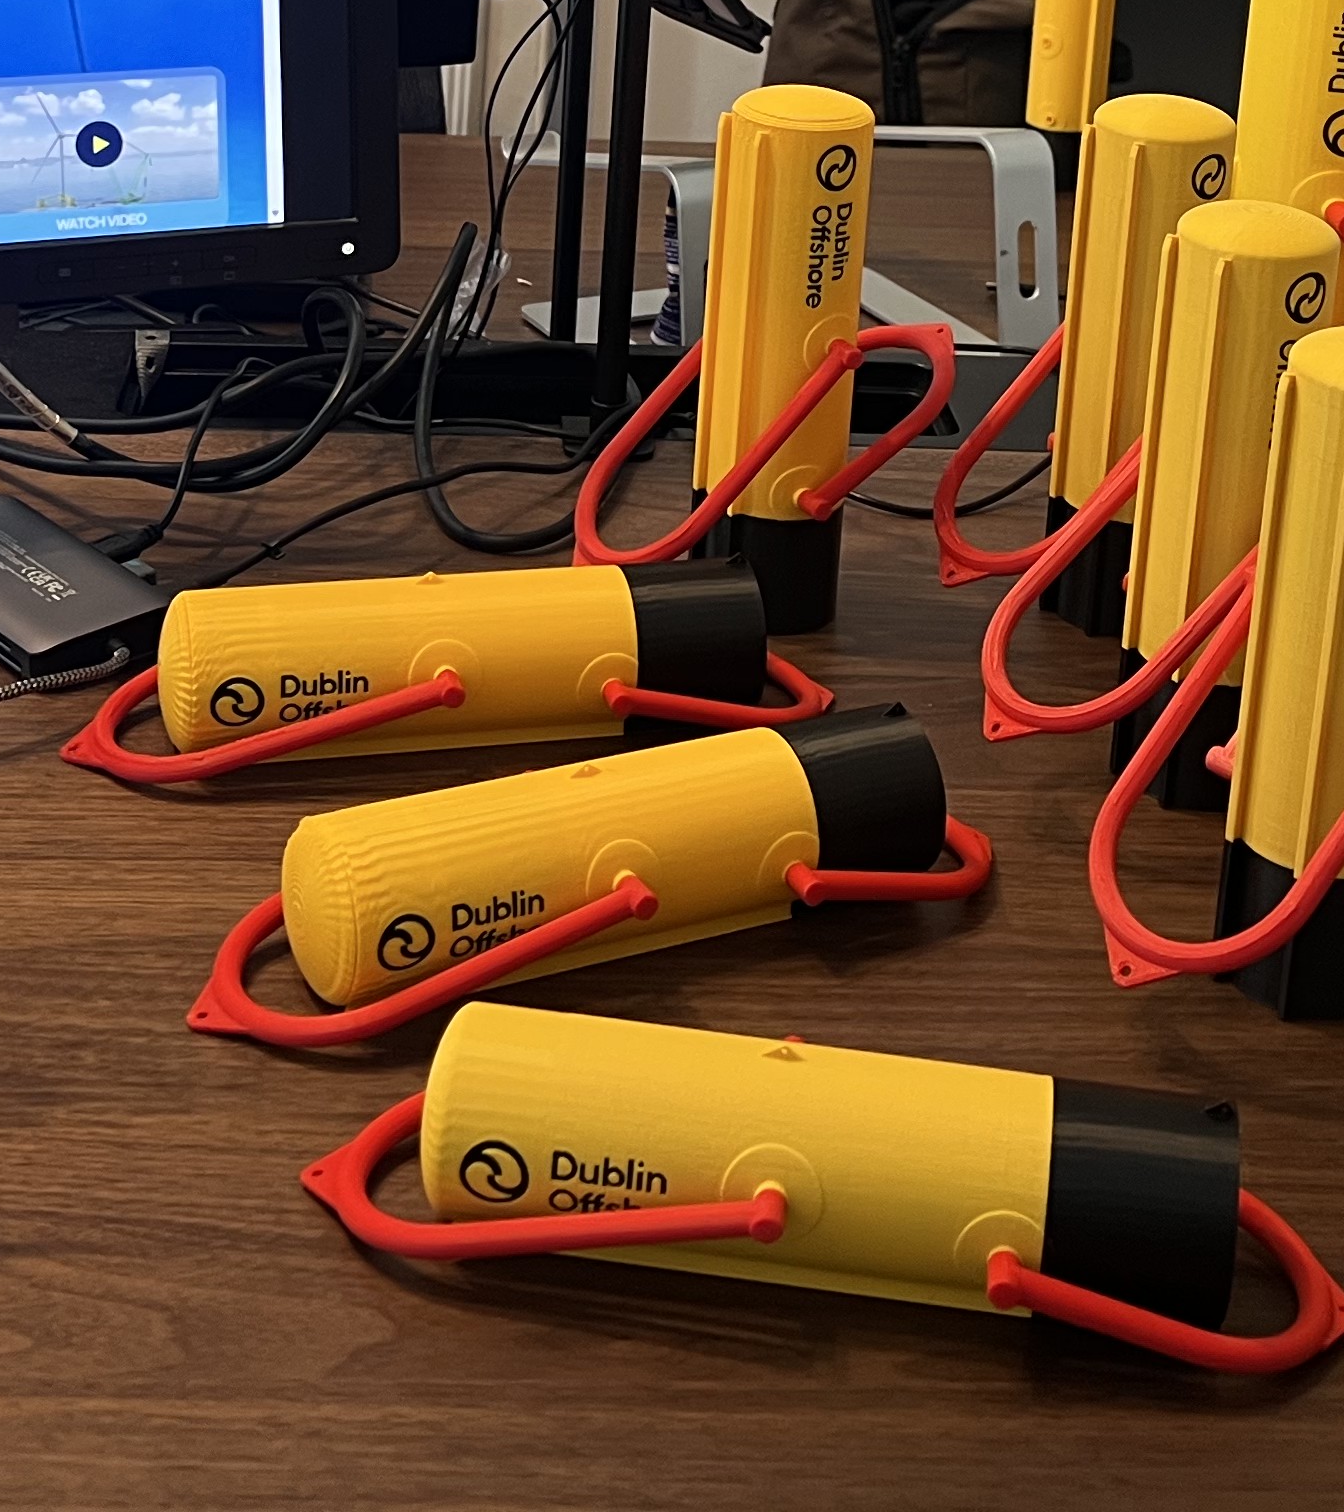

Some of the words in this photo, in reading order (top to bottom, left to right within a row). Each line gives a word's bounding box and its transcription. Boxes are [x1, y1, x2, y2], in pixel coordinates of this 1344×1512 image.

[56, 216, 106, 231] WATCH
[107, 212, 148, 228] VIDEO
[831, 202, 853, 281] Dublin
[805, 205, 833, 309] Offshore
[280, 670, 369, 699] Dublin
[451, 890, 545, 932] Dublin
[550, 1149, 668, 1195] Dublin
